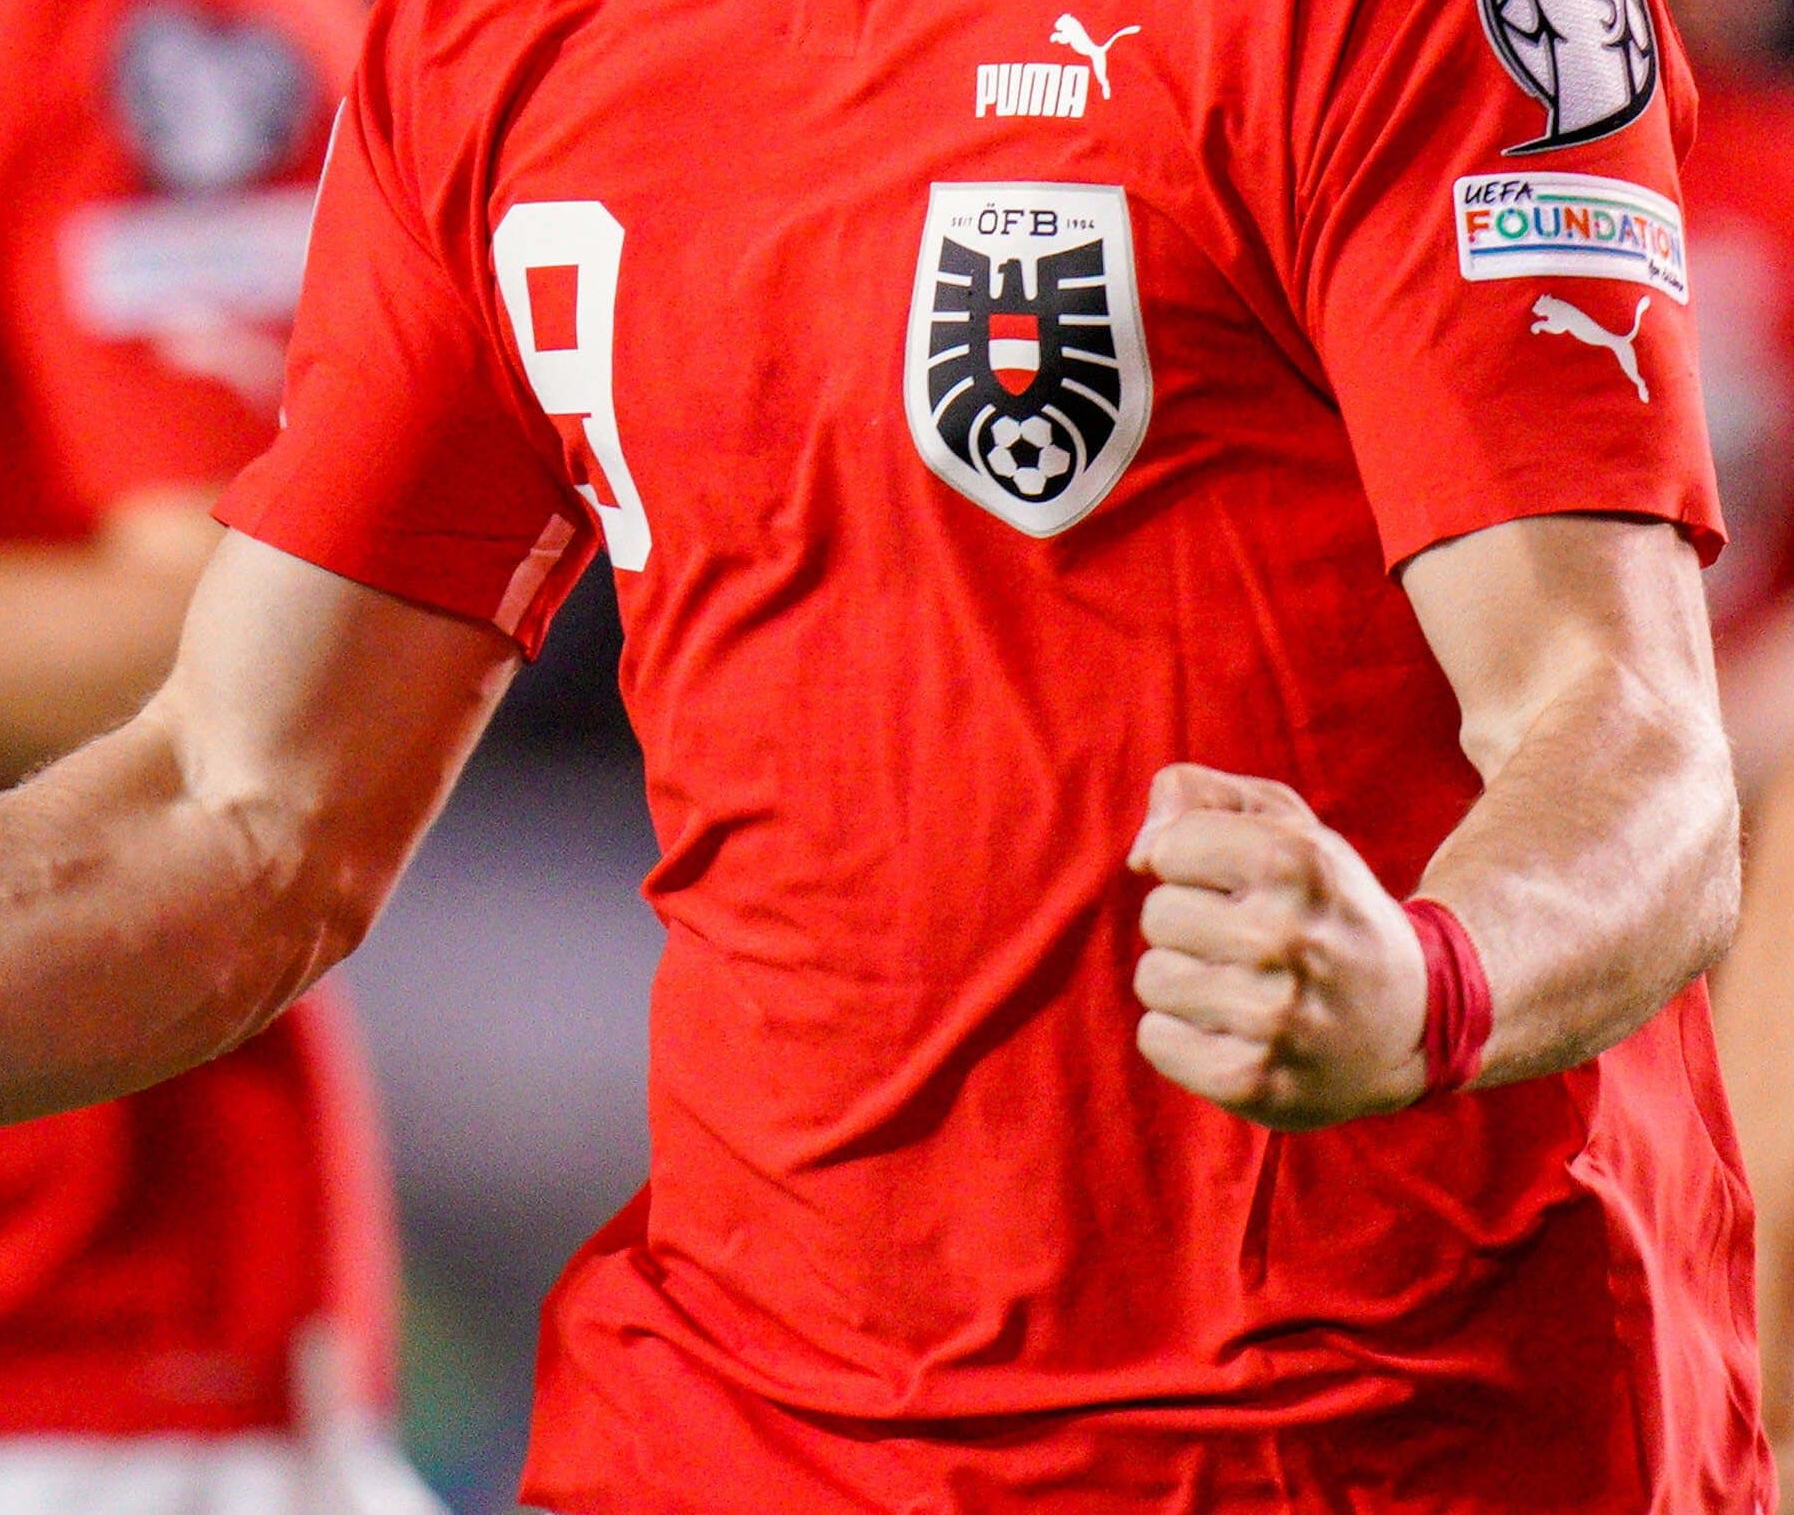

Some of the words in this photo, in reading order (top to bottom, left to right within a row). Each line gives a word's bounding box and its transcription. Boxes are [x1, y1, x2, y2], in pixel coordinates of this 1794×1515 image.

[975, 63, 1089, 118] PUMA
[977, 203, 1058, 236] ÖFB
[1464, 180, 1533, 205] UEFA
[1465, 206, 1682, 267] FOUNDATION
[493, 200, 653, 573] 9
